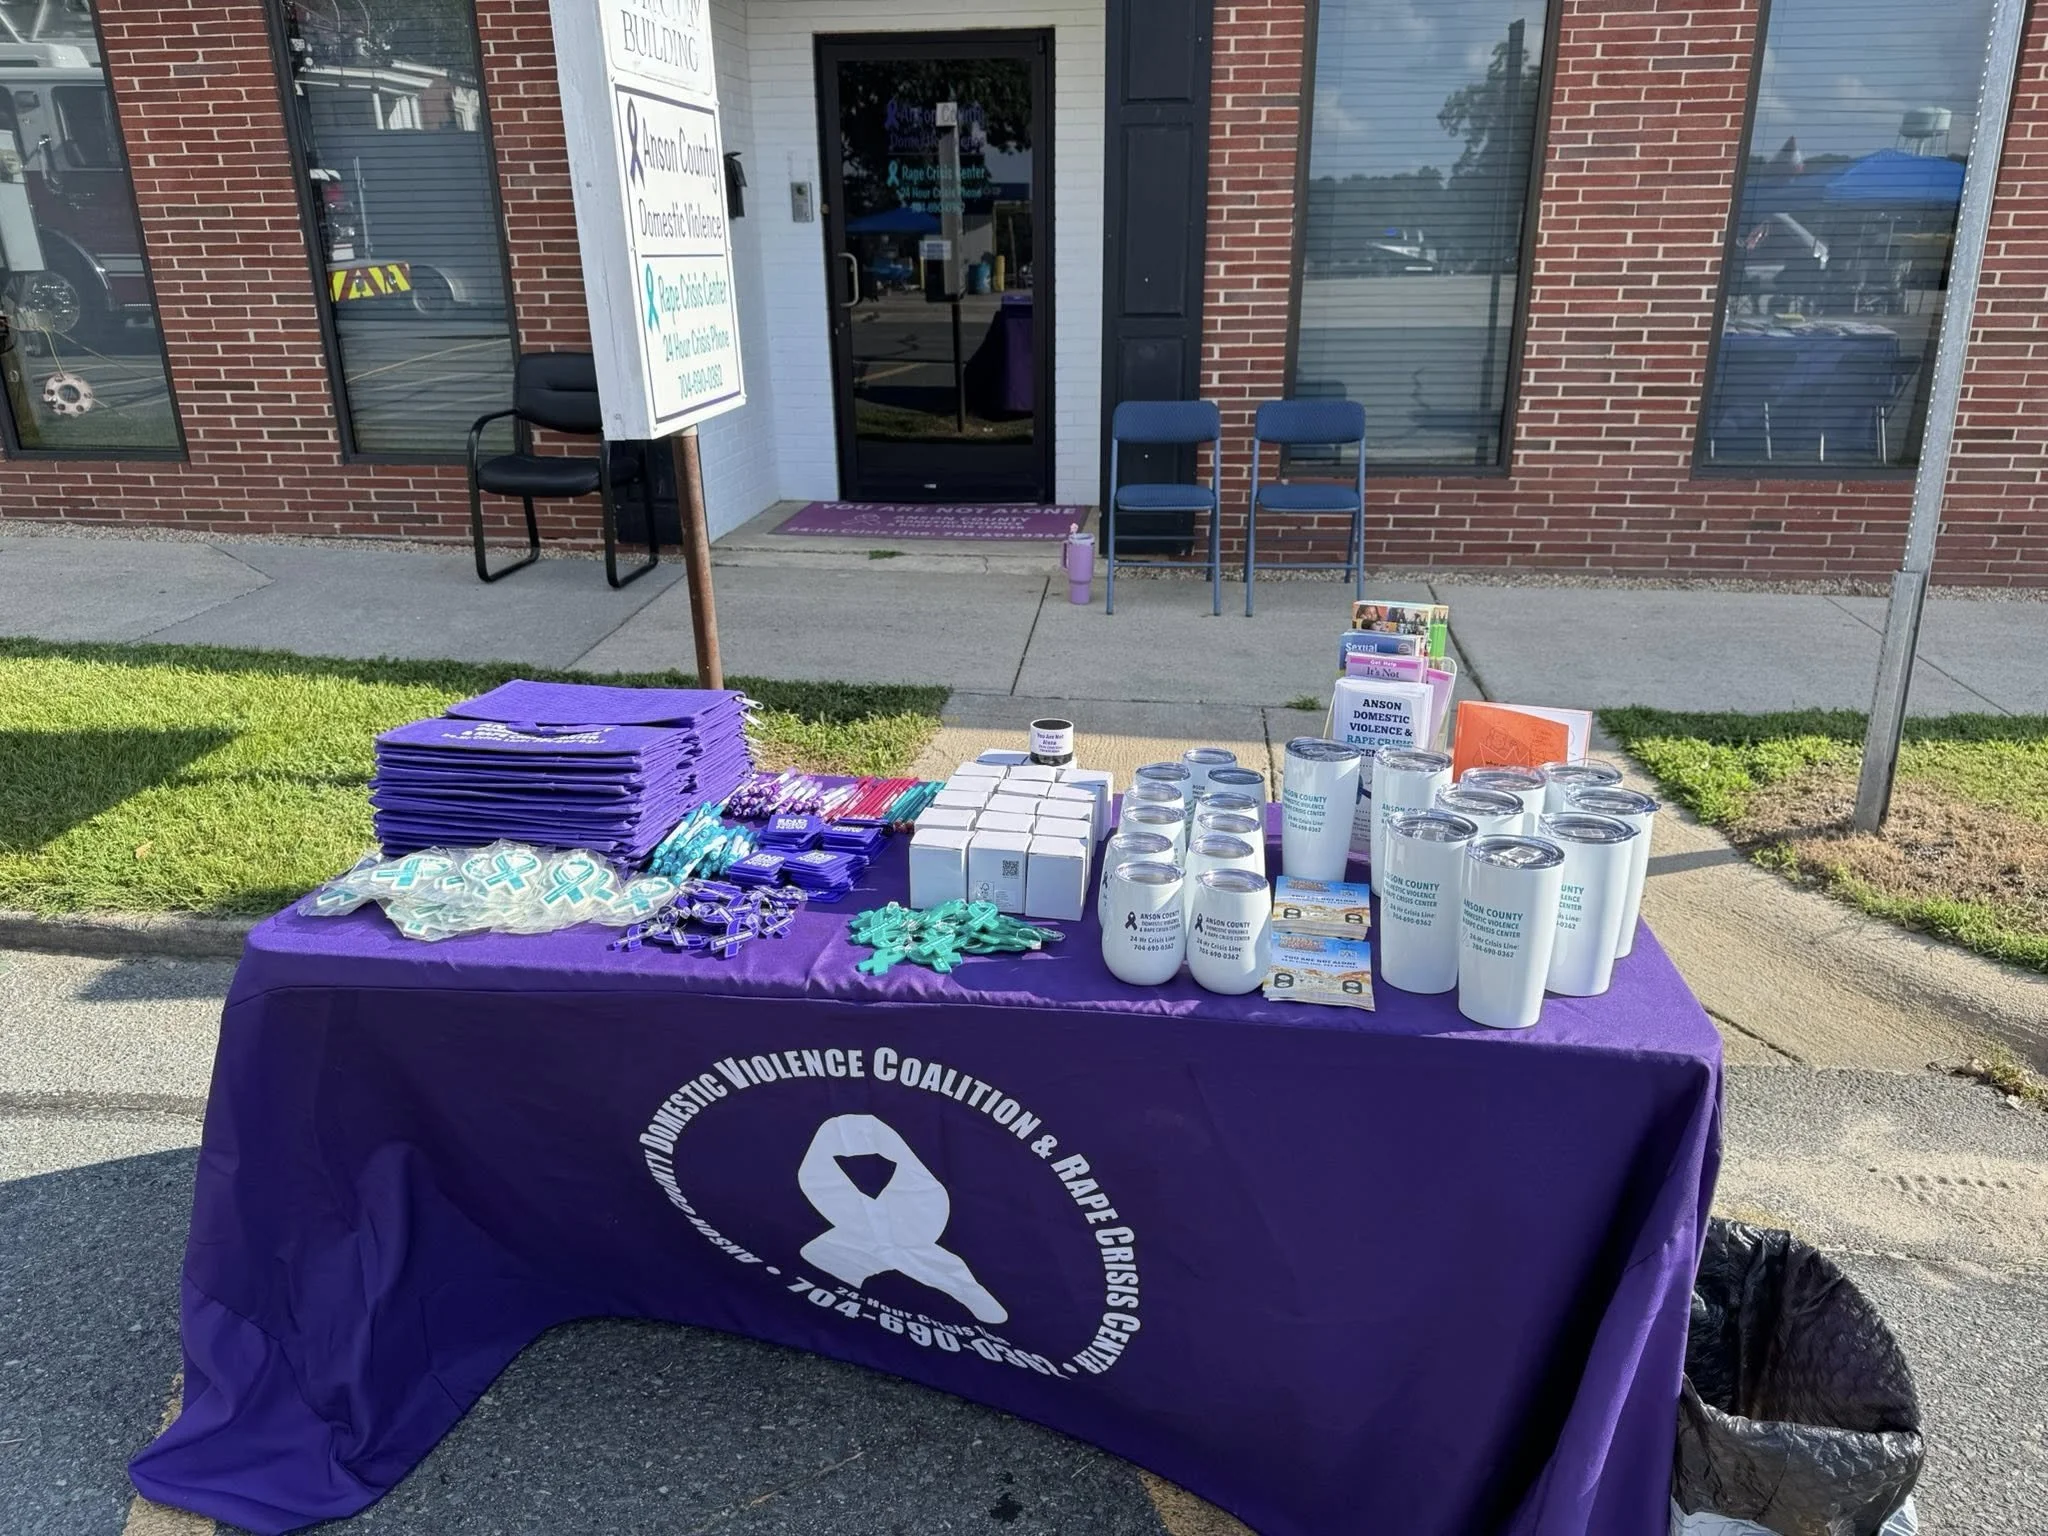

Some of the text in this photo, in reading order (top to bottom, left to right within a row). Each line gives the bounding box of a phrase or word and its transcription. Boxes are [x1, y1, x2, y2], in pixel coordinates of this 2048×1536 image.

[621, 9, 699, 73] BUILDING
[642, 117, 718, 194] Anson County
[902, 166, 923, 182] Rape
[638, 198, 723, 240] Domestic Violence
[657, 270, 728, 325] Rape Crisis Center
[662, 324, 730, 363] 24 Hour Crisis Phone
[823, 503, 873, 511] YOU
[878, 505, 929, 513] ARE
[992, 507, 1077, 515] ALONE
[1345, 642, 1378, 652] Sexual
[1366, 666, 1400, 678] It's Not
[1362, 699, 1402, 711] ANSON
[1353, 710, 1410, 724] DOMESTIC
[1350, 722, 1413, 737] VIOLENCE &
[1346, 735, 1376, 746] RAPE
[1299, 793, 1327, 803] COUNTY
[1405, 879, 1440, 891] COUNTY
[1406, 889, 1436, 900] VIOLENCE
[1414, 899, 1438, 907] CENTER
[1463, 898, 1523, 921] ANSON COUNTY
[1205, 916, 1250, 928] ANSON COUNTY
[1487, 919, 1520, 930] VIOLENCE
[1476, 924, 1495, 935] CRISIS
[1496, 929, 1521, 939] CENTER
[1148, 936, 1164, 944] Crisis
[1477, 935, 1485, 943] Hr
[1485, 938, 1502, 949] Crisis
[1210, 943, 1228, 951] Crisis
[639, 1046, 1141, 1375] ANSON COUNTY DOMESTIC VIOLENCE COALITION & RAPE CRISIS CENTER
[834, 1286, 913, 1320] 24-Hour
[917, 1313, 976, 1337] Crisis
